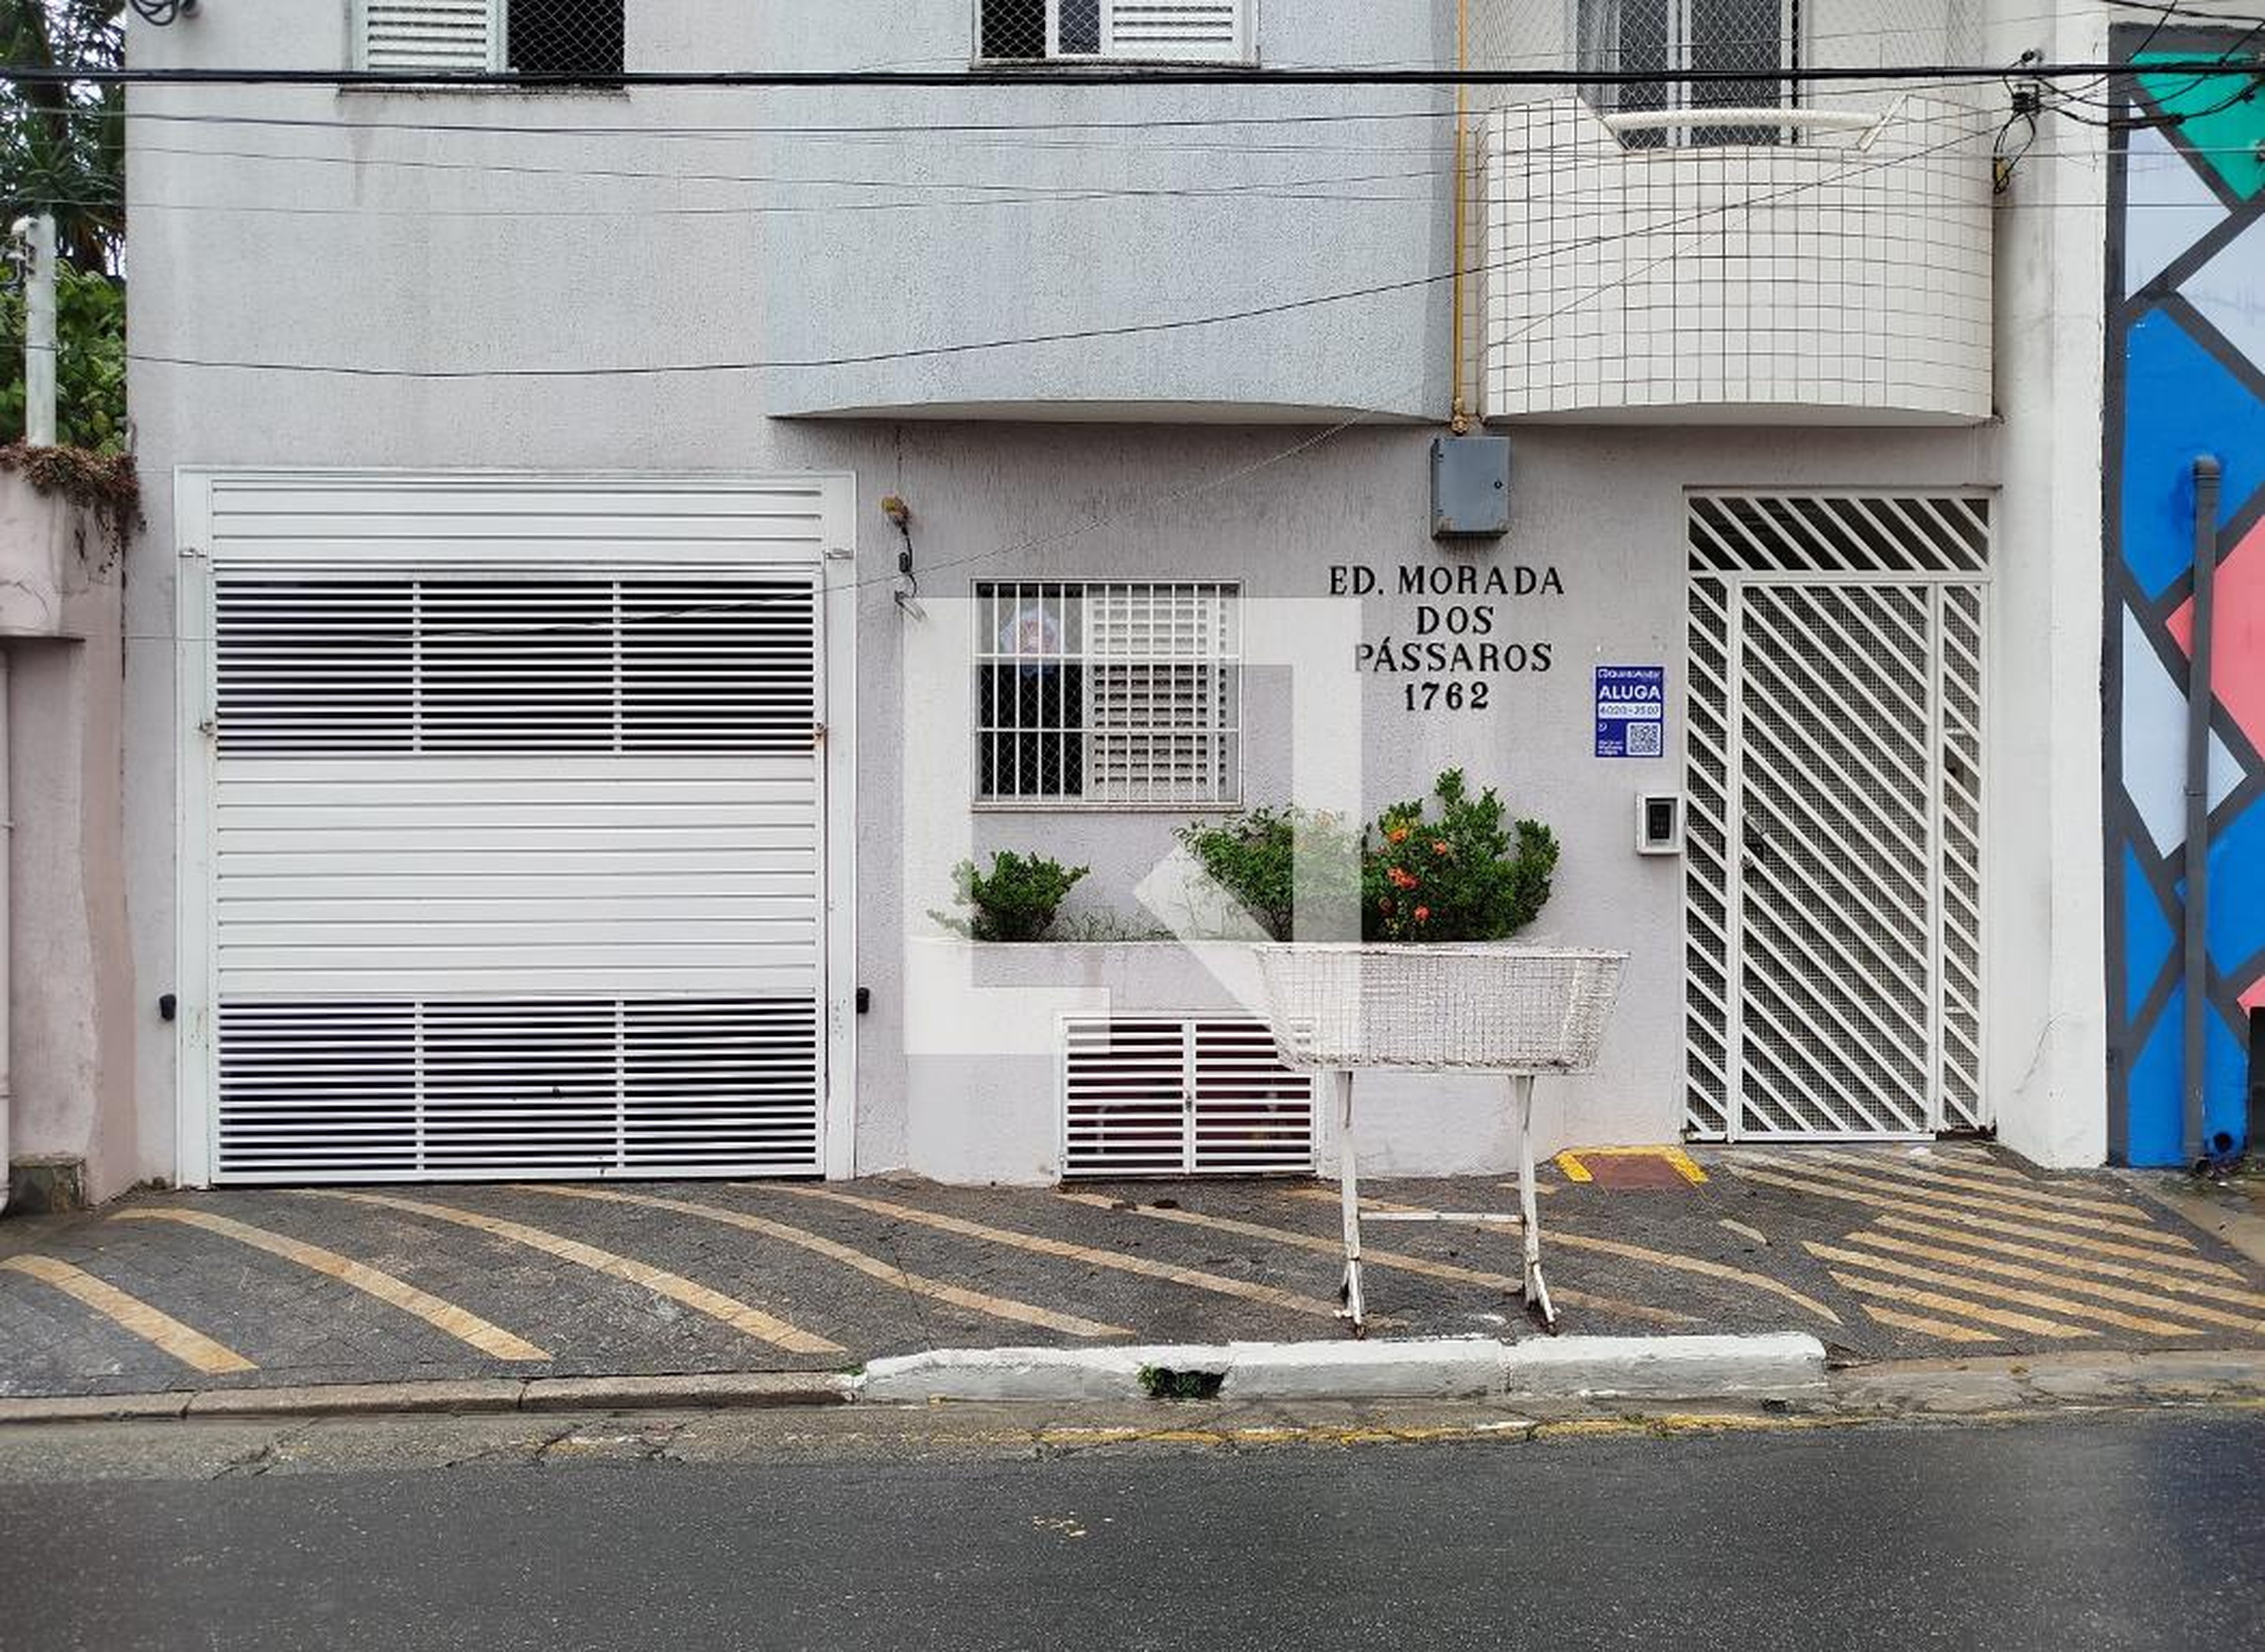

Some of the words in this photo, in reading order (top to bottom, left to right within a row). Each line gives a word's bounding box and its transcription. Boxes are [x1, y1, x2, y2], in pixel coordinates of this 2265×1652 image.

[1330, 566, 1383, 595] ED.
[1399, 566, 1564, 594] MORADA
[1417, 606, 1493, 634] DOS
[1355, 636, 1552, 672] PÁSSAROS
[1405, 681, 1489, 710] 1762
[1598, 685, 1661, 699] ALUGA
